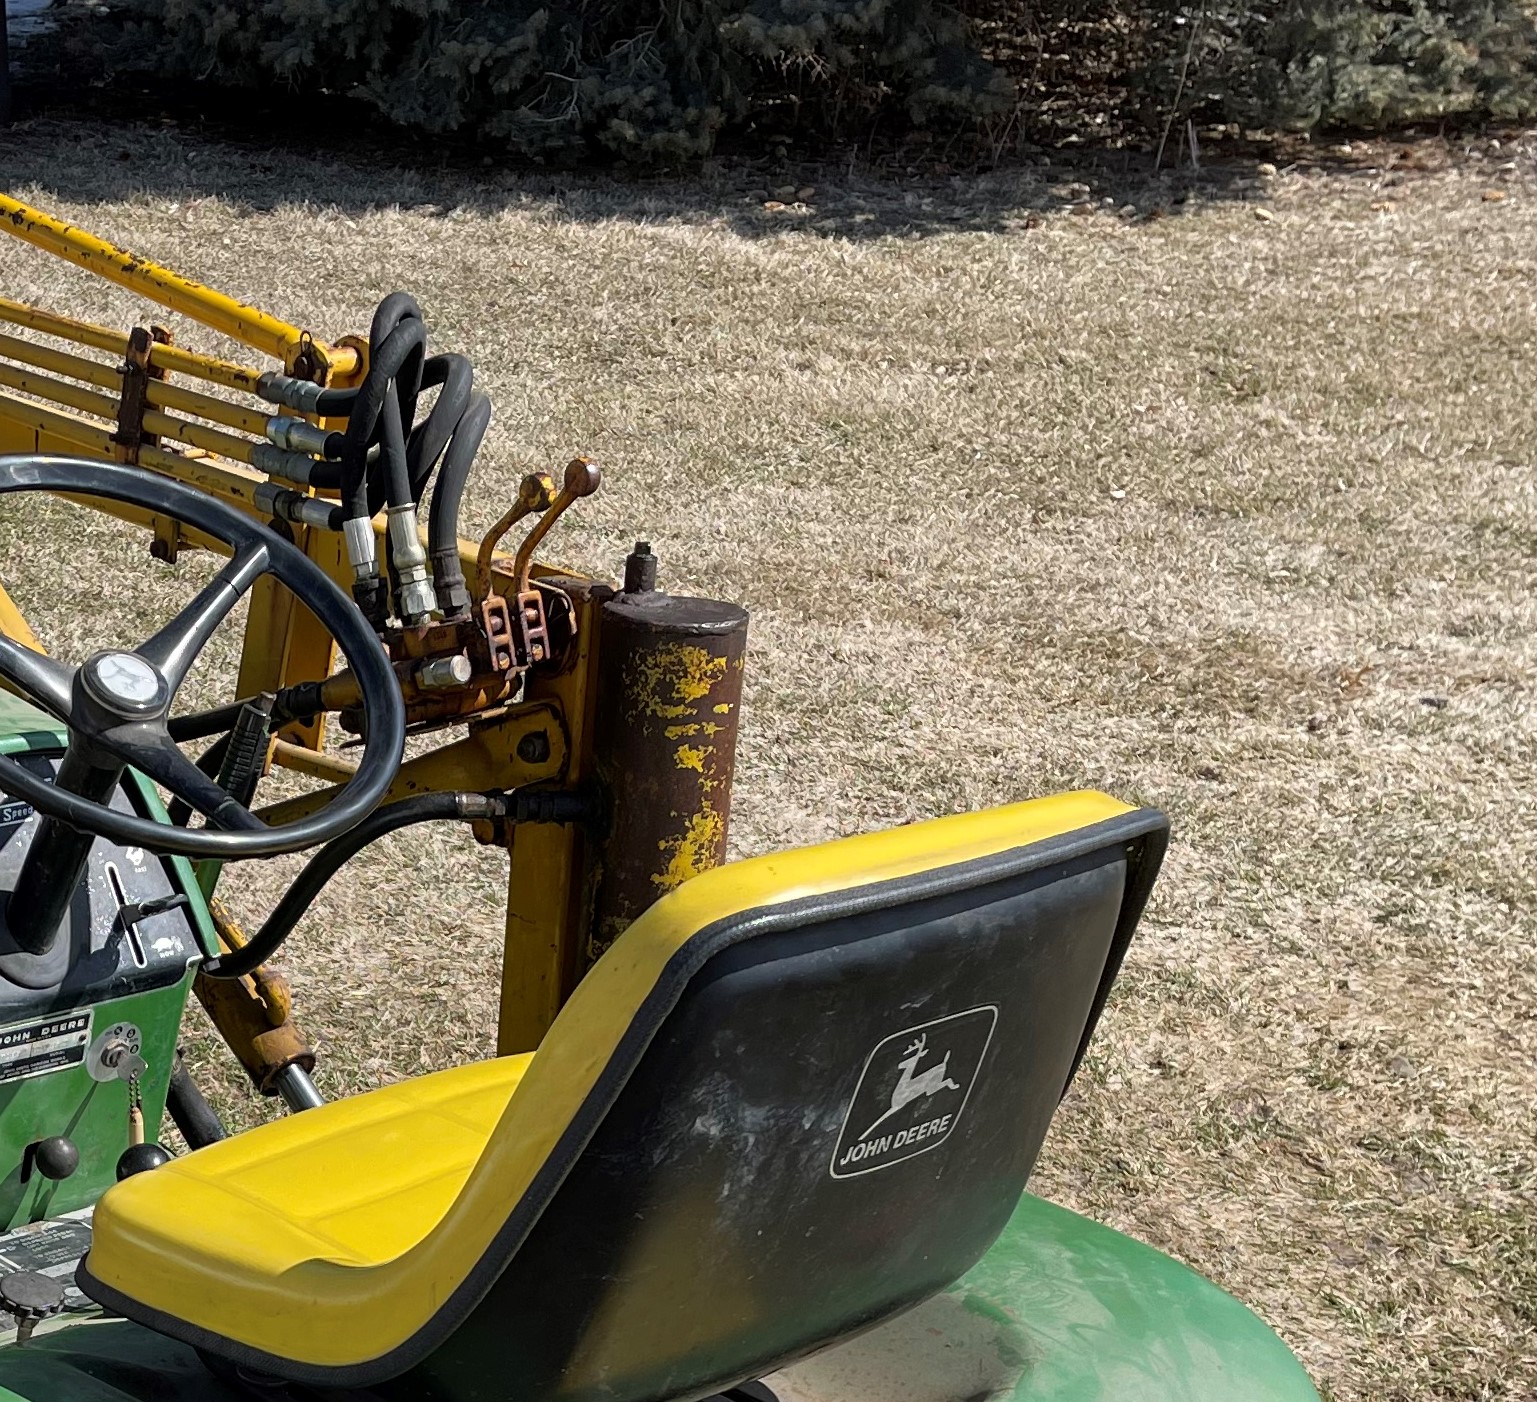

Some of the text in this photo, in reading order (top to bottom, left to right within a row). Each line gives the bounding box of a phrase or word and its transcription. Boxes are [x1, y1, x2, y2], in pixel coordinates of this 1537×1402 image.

[3, 806, 34, 822] Speed
[41, 1018, 86, 1036] DEERE
[840, 1113, 952, 1167] JOHN DEERE
